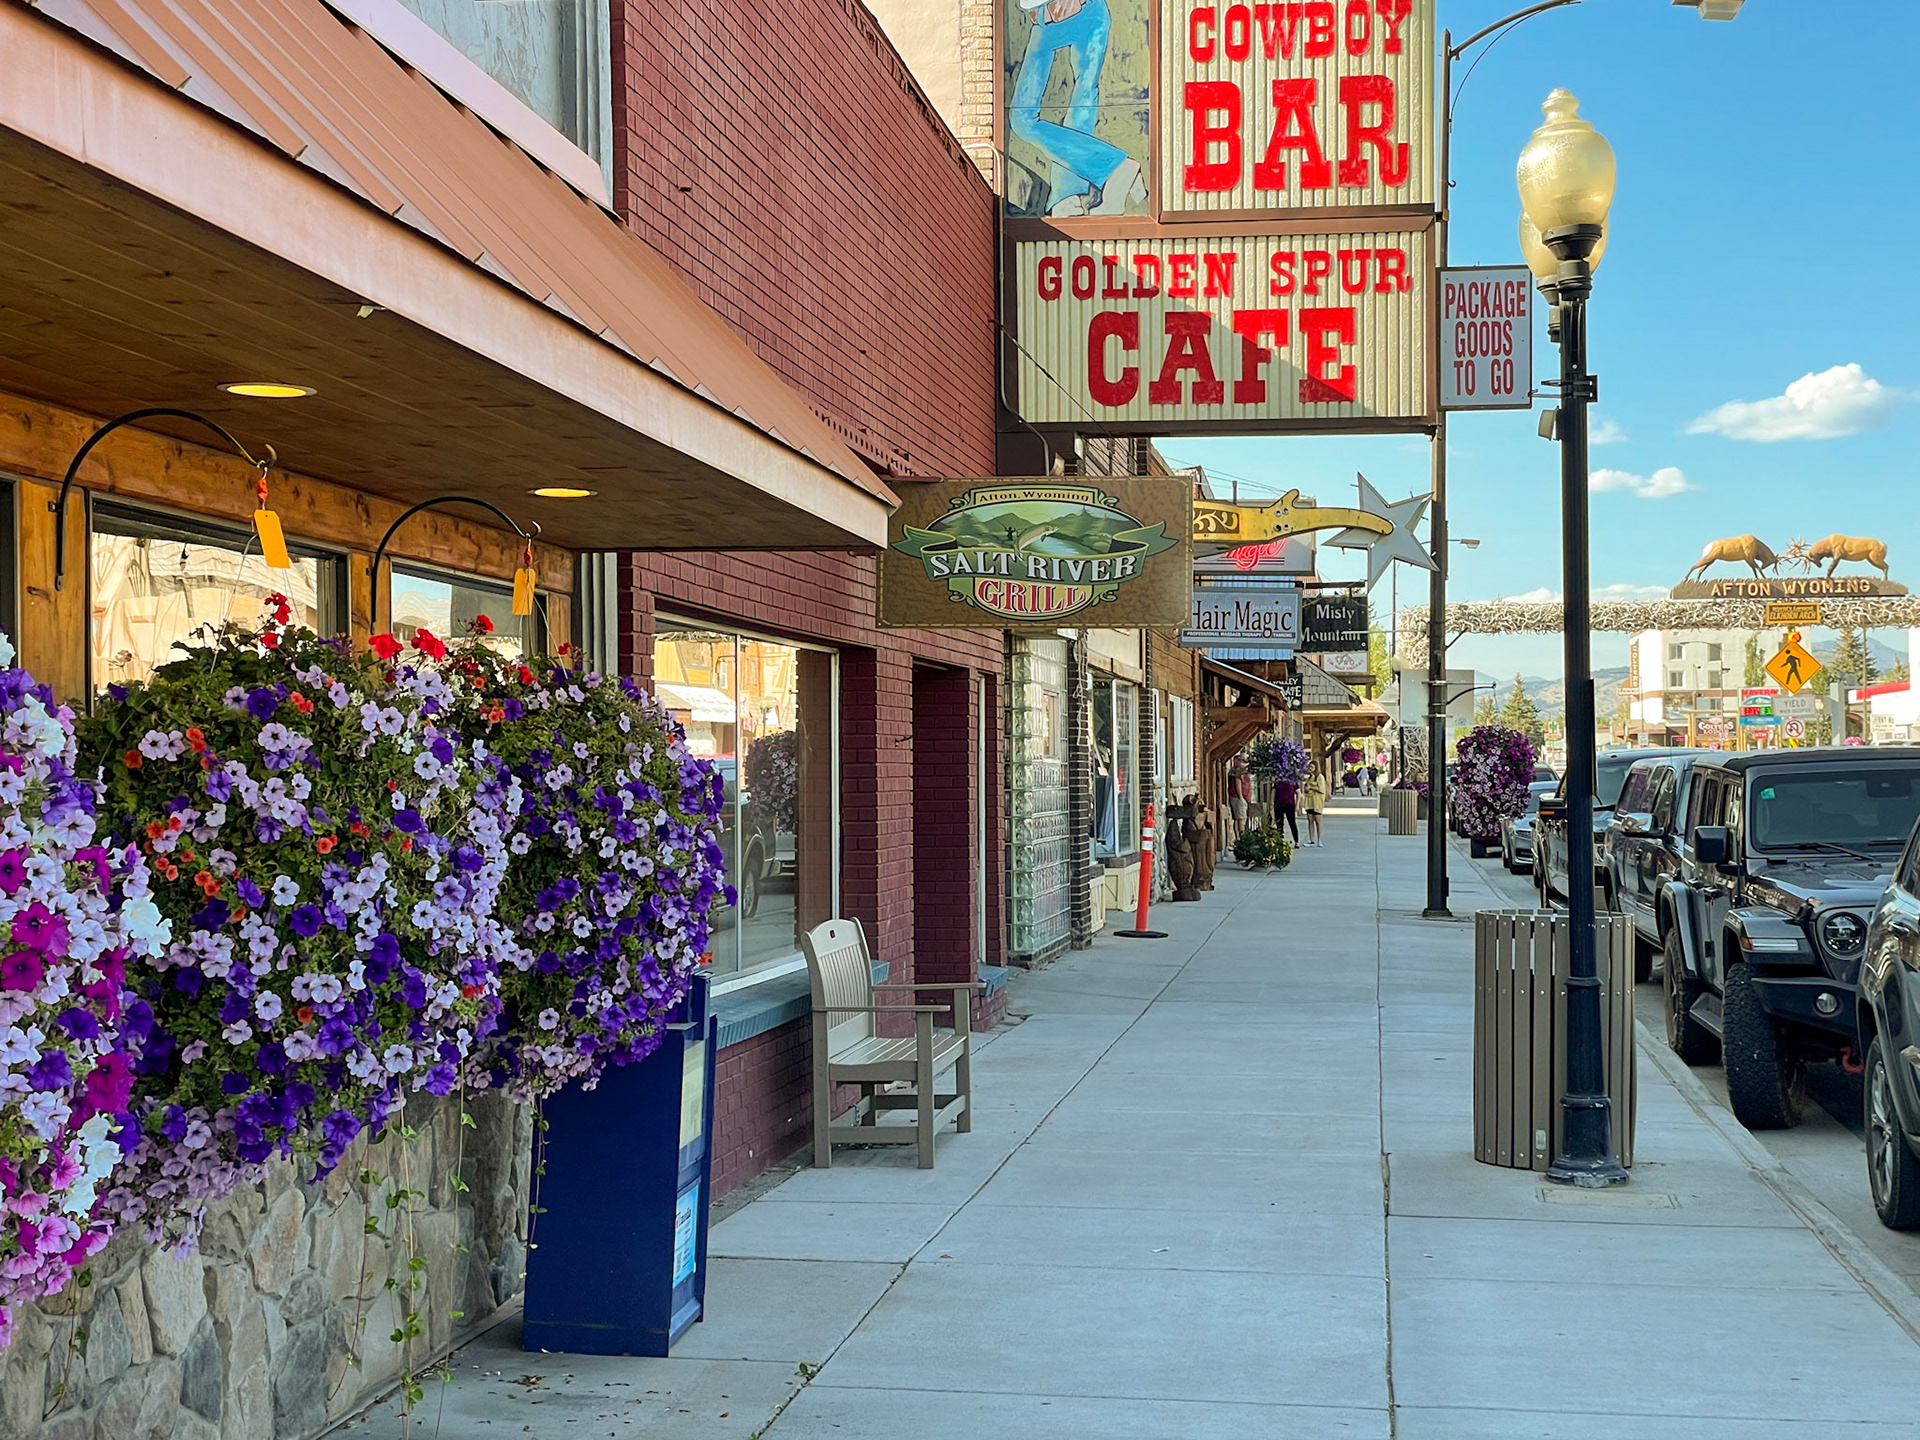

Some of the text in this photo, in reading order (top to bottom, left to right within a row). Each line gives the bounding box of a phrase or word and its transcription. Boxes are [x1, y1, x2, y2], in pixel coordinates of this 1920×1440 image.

[1189, 0, 1411, 63] COWBOY
[1184, 75, 1410, 192] BAR
[1037, 248, 1412, 300] GOLDEN SPUR
[1445, 280, 1526, 319] PACKAGE
[1088, 307, 1357, 407] CAFE
[1455, 319, 1513, 358] GOODS
[1453, 358, 1514, 396] TO GO
[1023, 490, 1090, 502] Wyoming
[929, 551, 1139, 582] SALT RIVER
[977, 579, 1087, 614] GRILL
[1711, 578, 1871, 597] AFTON WYOMING
[1192, 600, 1293, 639] Hair Magic
[1316, 604, 1355, 625] Misty
[1783, 699, 1806, 708] YIELD
